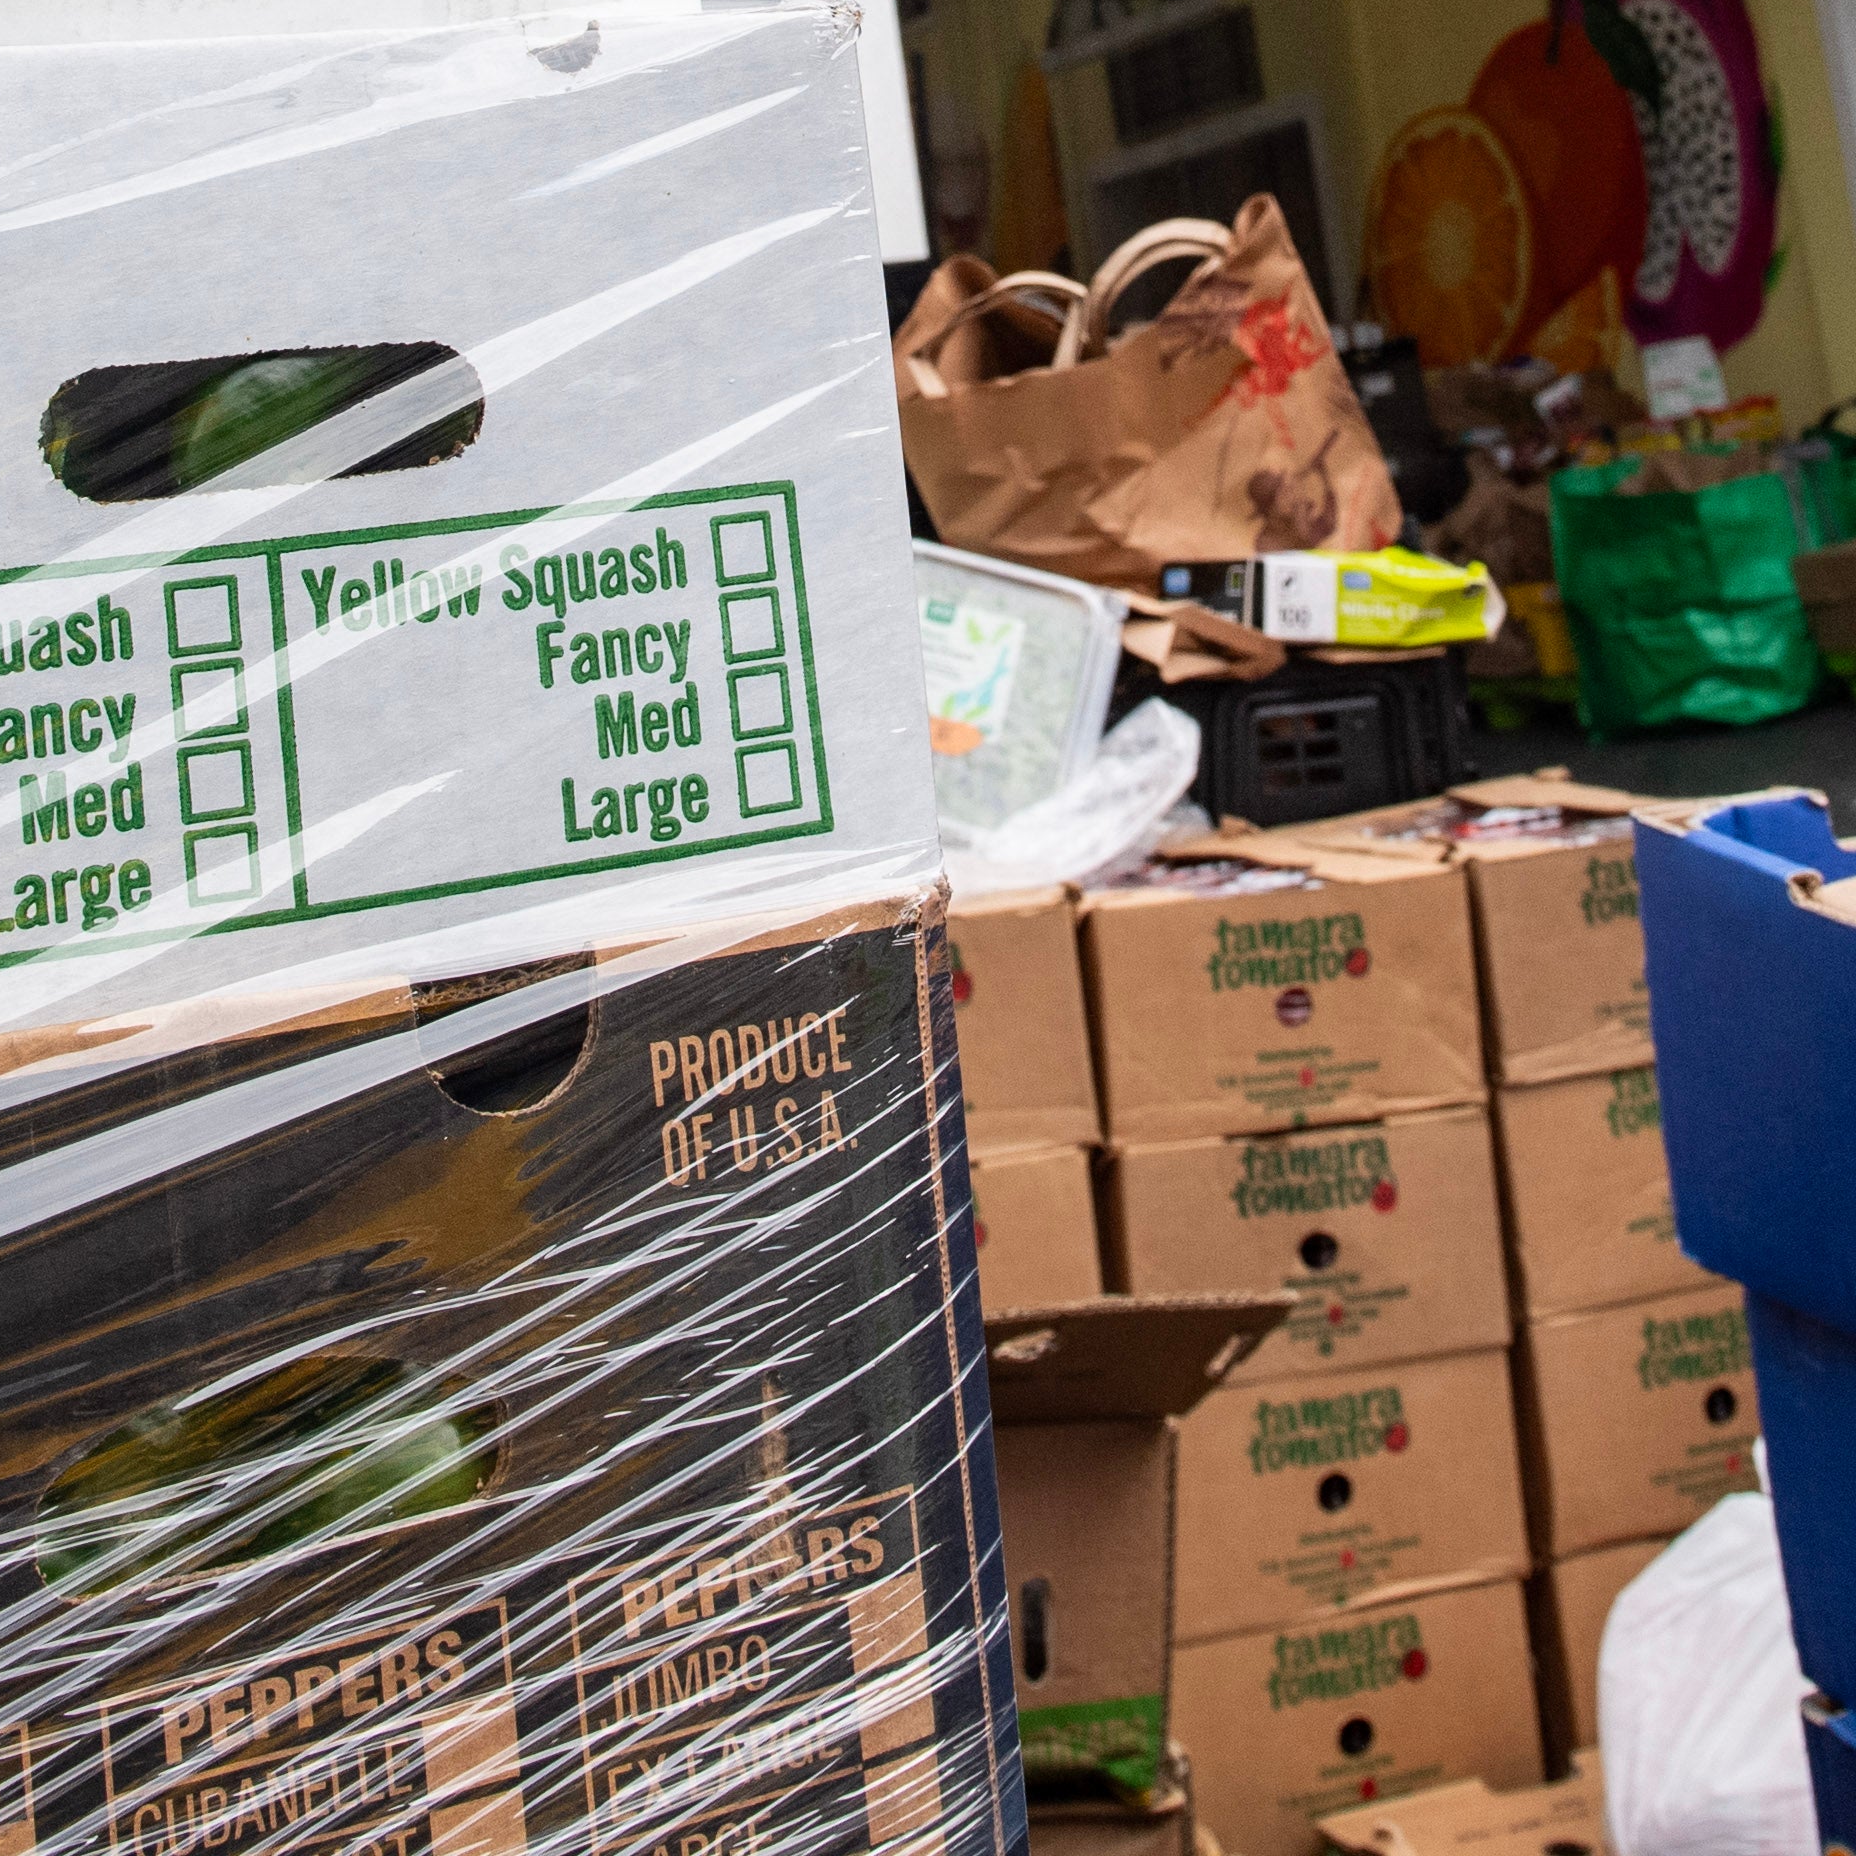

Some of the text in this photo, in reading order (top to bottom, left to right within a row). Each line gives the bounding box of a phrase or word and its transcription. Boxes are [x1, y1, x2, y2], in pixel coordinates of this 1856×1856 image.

[302, 526, 689, 639] Yellow Squash
[536, 609, 694, 696] Fancy
[594, 687, 704, 762] Med
[19, 769, 146, 846] Med
[559, 774, 714, 846] Large
[1206, 947, 1346, 994] tomato
[1212, 914, 1366, 959] tamara
[649, 1006, 852, 1108] PRODUCE
[662, 1089, 859, 1187] OF U.S.A.
[162, 1630, 466, 1766] PEPPERS
[602, 1634, 772, 1732] JUMBO
